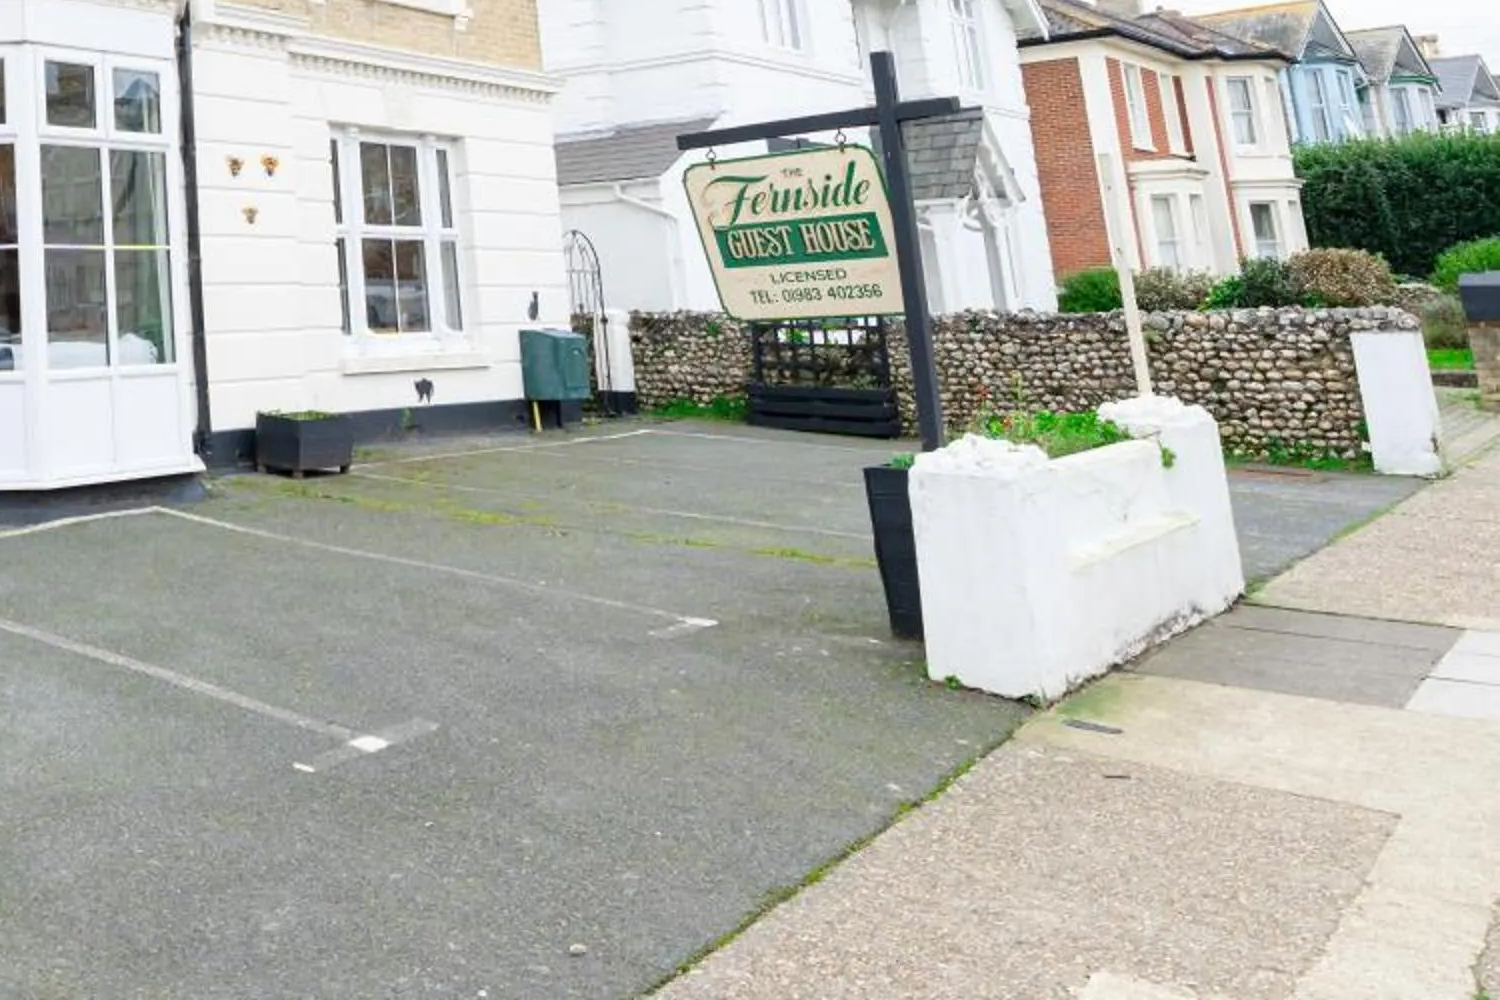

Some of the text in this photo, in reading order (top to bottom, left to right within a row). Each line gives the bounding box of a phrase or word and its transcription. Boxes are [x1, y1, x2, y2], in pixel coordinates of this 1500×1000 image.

[780, 167, 803, 177] THE
[702, 160, 871, 227] Fernside
[727, 218, 876, 259] GUEST HOUSE
[769, 267, 847, 284] LICENSED
[750, 284, 883, 304] TEL: 01983 402356
